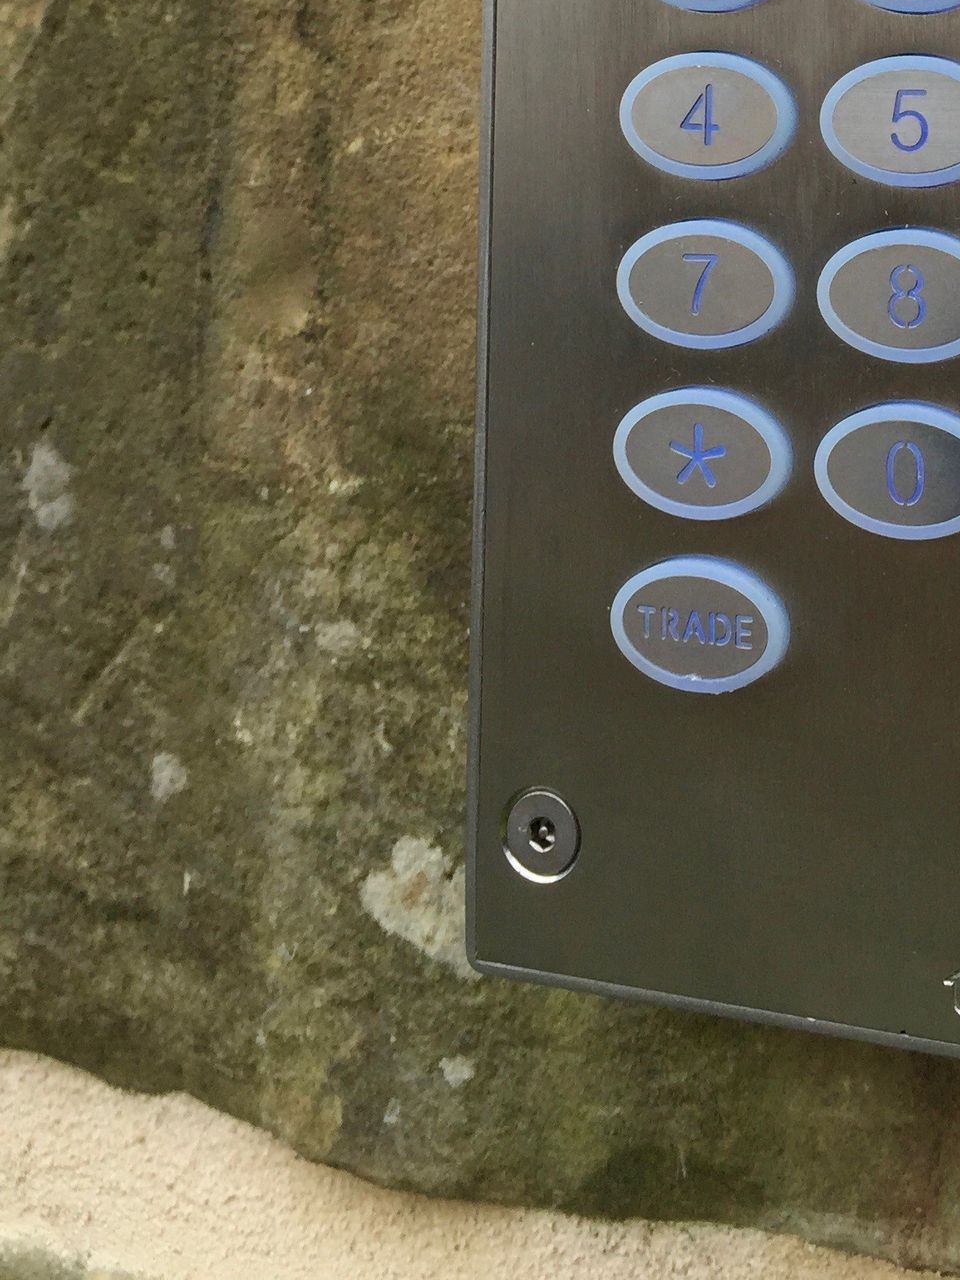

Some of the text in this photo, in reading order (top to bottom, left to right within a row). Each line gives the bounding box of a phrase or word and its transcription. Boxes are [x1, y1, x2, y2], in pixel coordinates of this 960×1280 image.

[679, 83, 720, 146] 4
[890, 88, 929, 152] 5
[682, 252, 719, 315] 7
[888, 263, 925, 328] 8
[886, 441, 925, 507] 0
[637, 603, 754, 651] TRADE
